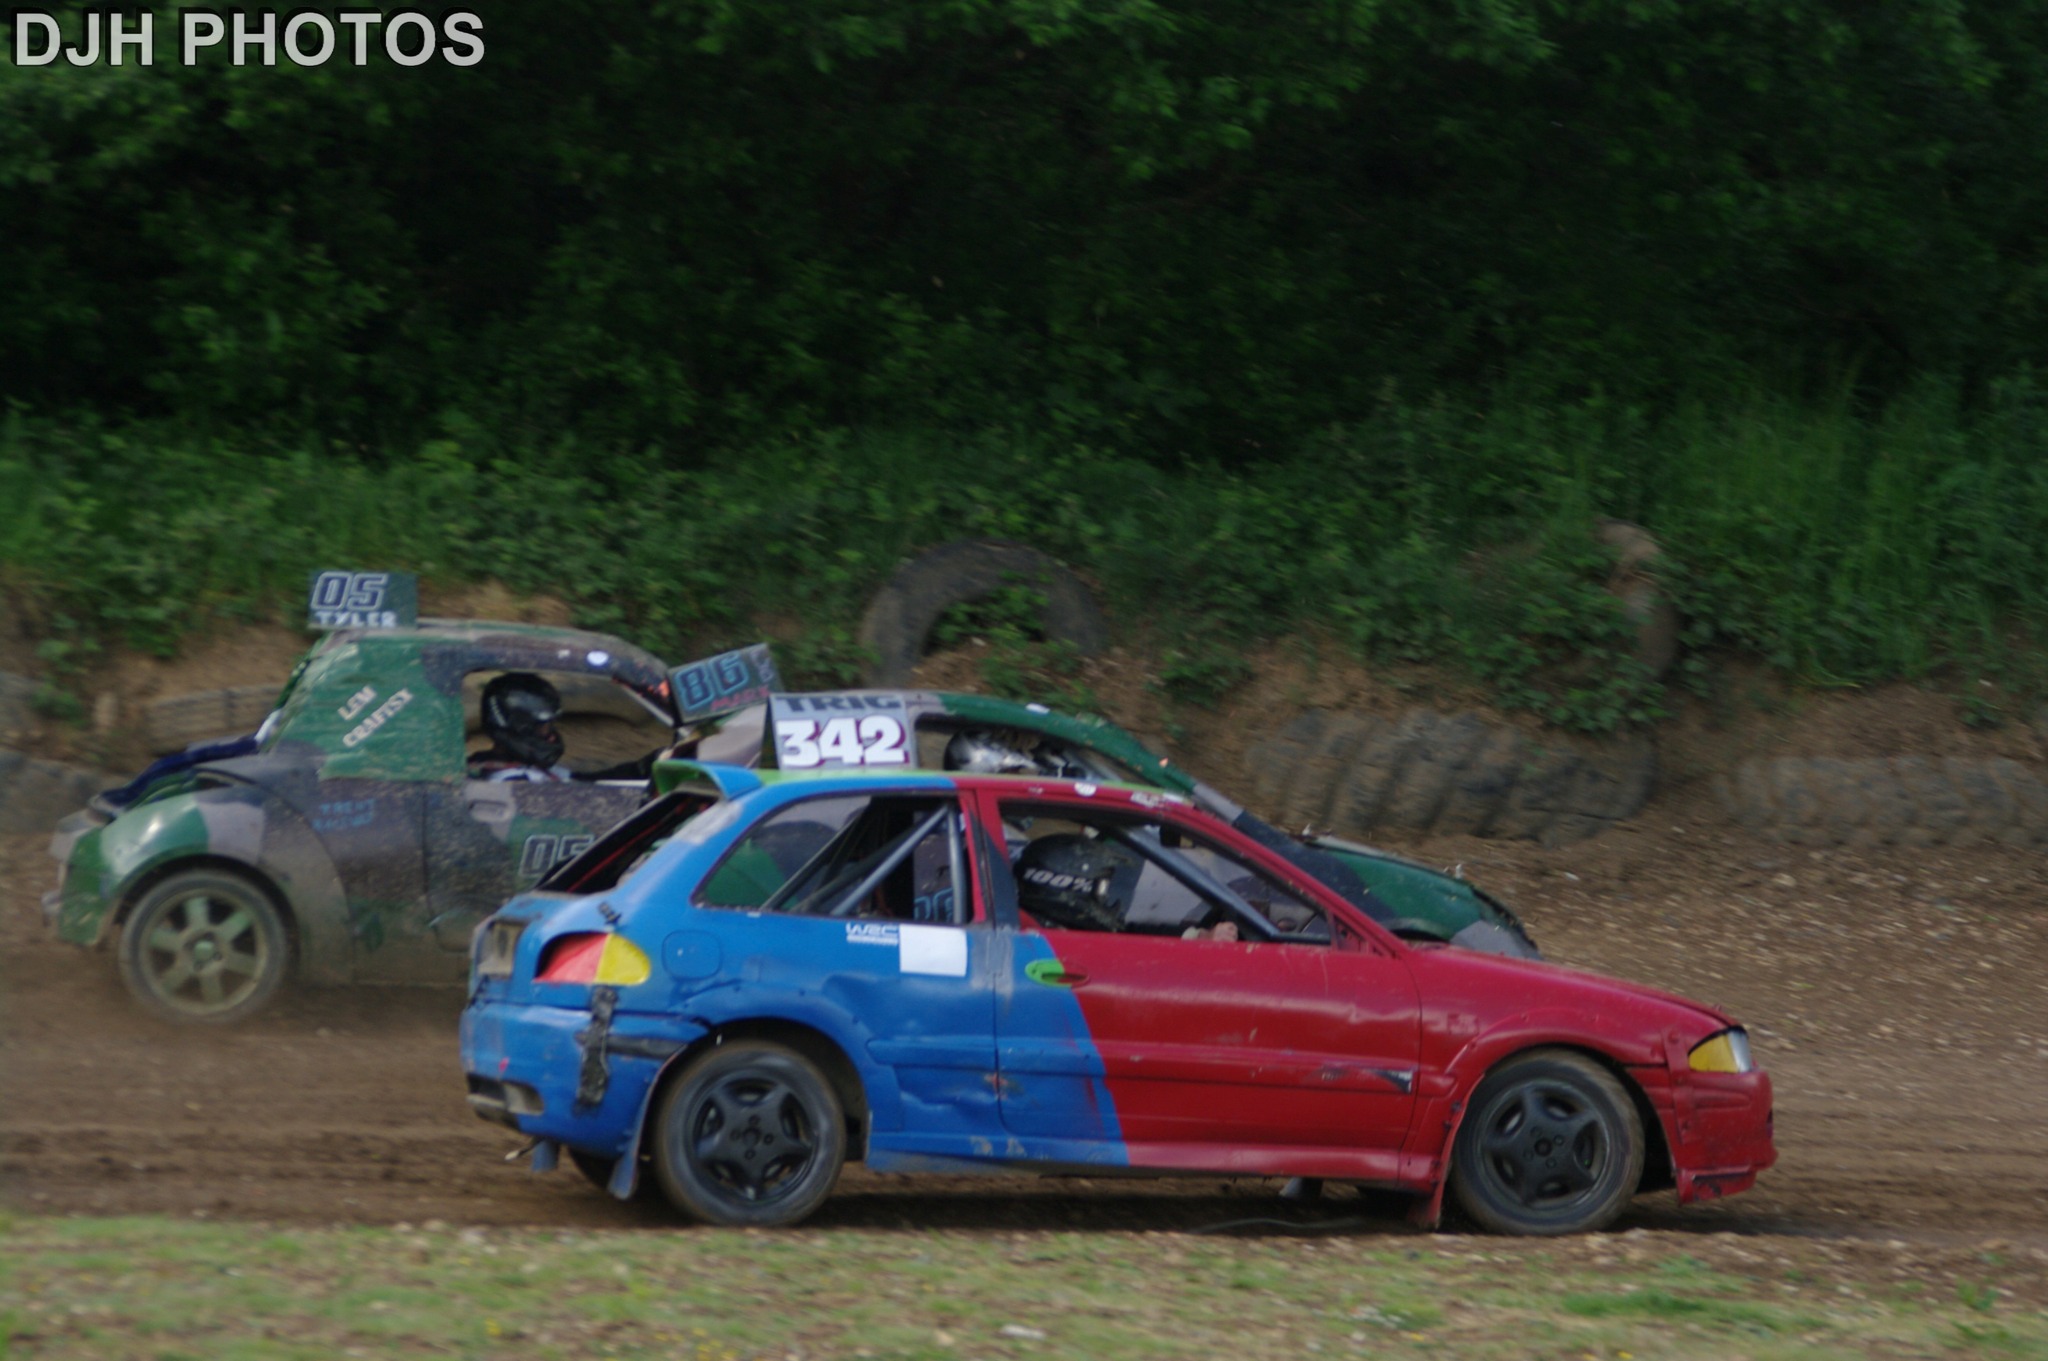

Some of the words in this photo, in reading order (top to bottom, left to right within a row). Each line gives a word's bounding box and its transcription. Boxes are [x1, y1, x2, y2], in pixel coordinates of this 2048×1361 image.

[310, 571, 389, 610] 05
[315, 611, 397, 627] TYLER
[674, 650, 749, 711] 86
[776, 695, 902, 712] TRIG
[776, 715, 909, 769] 342
[1023, 867, 1094, 893] 100%
[845, 922, 898, 938] WRC
